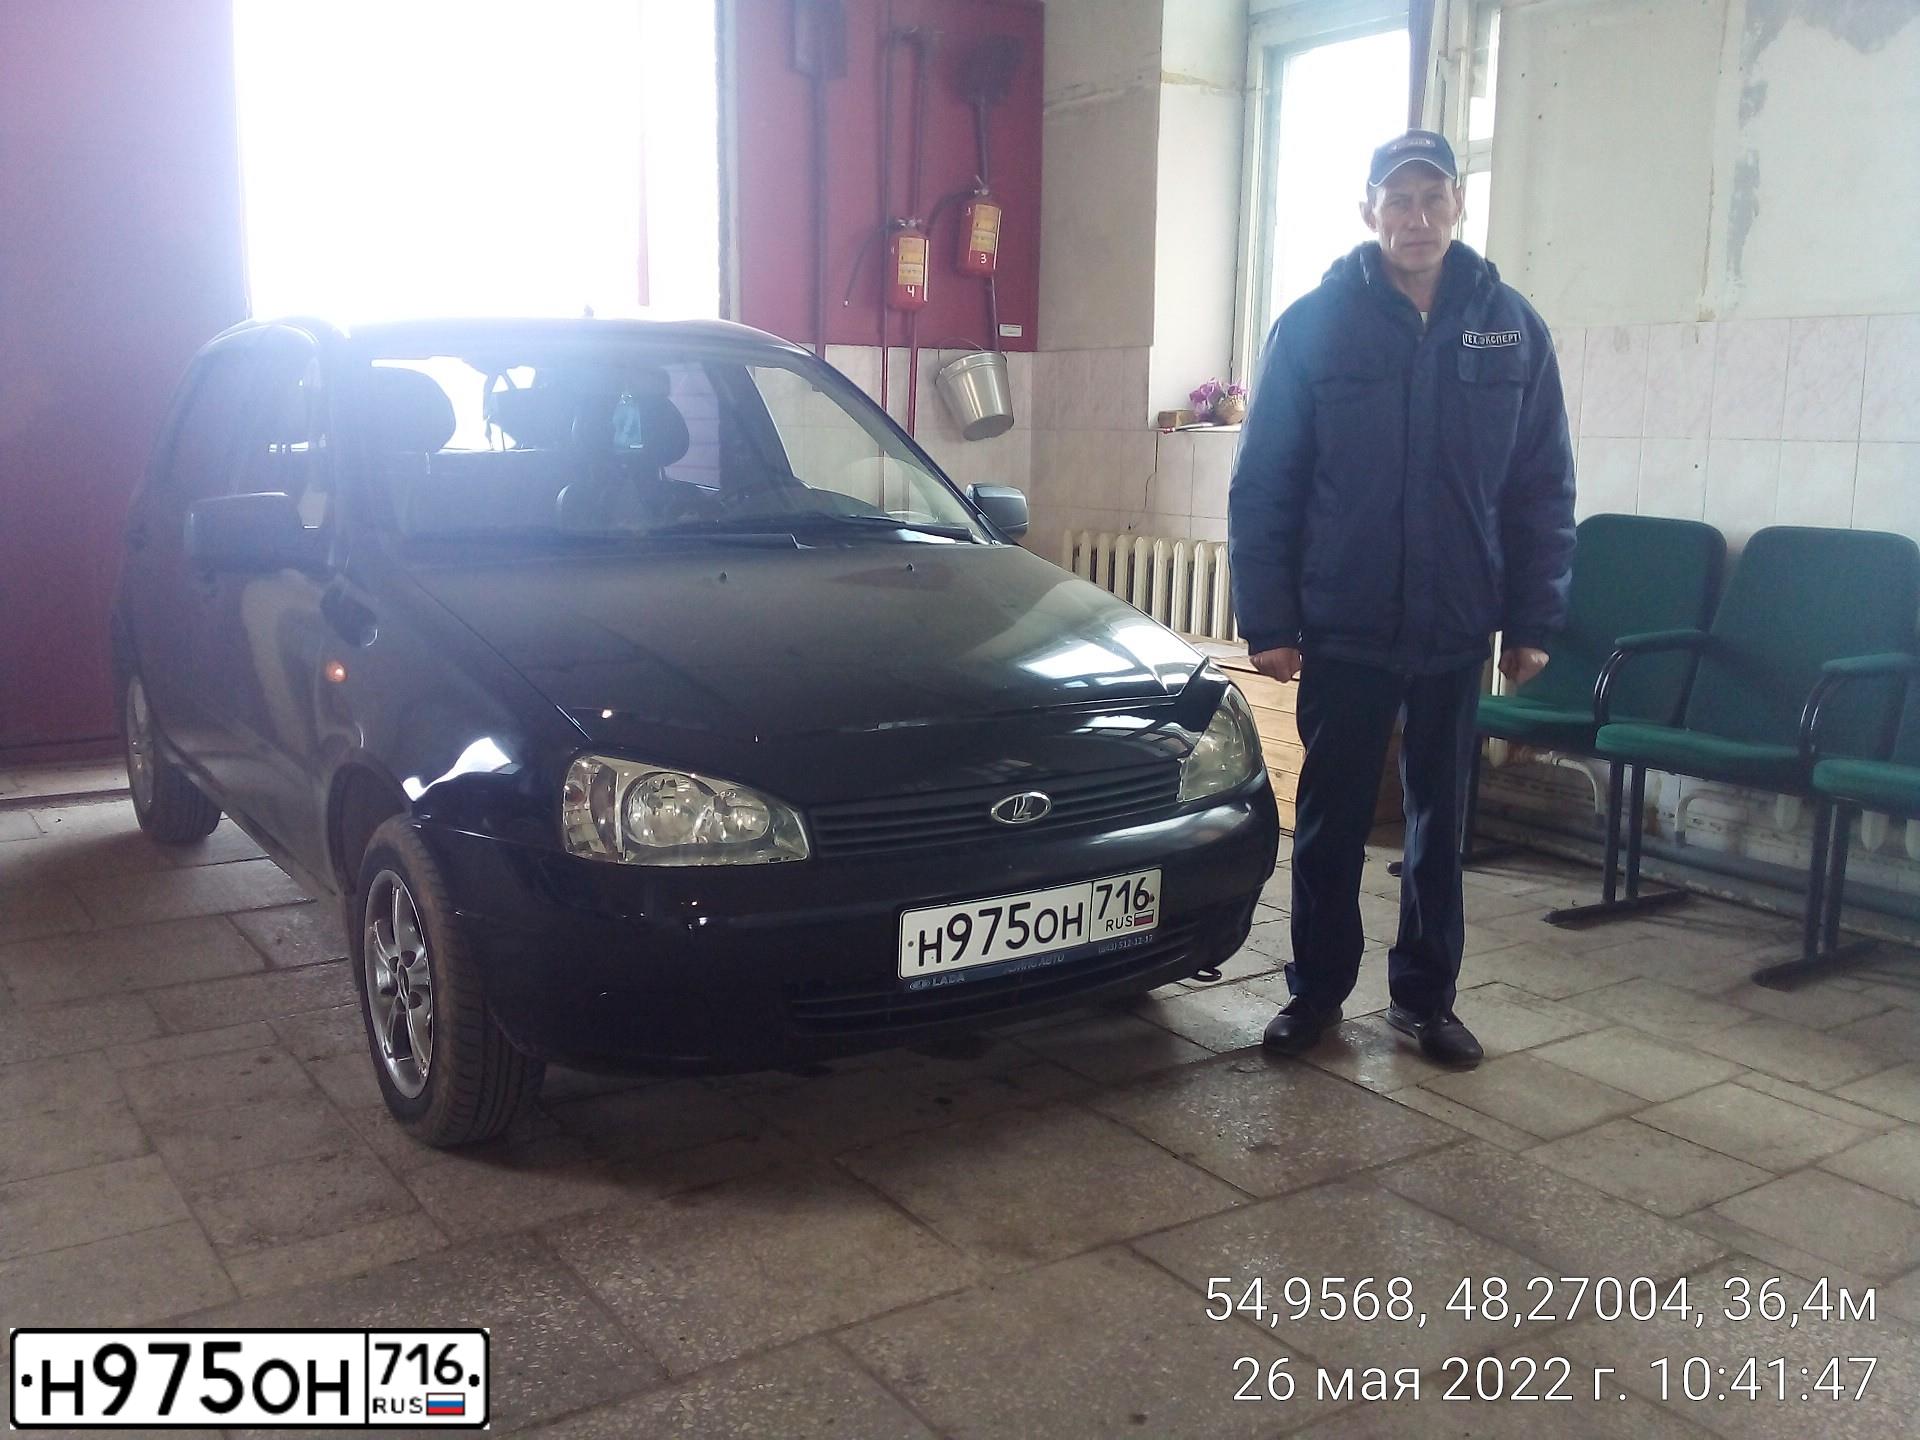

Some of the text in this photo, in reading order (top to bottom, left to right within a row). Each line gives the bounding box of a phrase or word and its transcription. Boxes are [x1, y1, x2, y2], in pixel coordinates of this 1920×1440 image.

[980, 253, 987, 264] 3
[907, 285, 915, 298] 4
[918, 877, 1150, 967] Н975ОН 716
[1105, 915, 1133, 932] RUS
